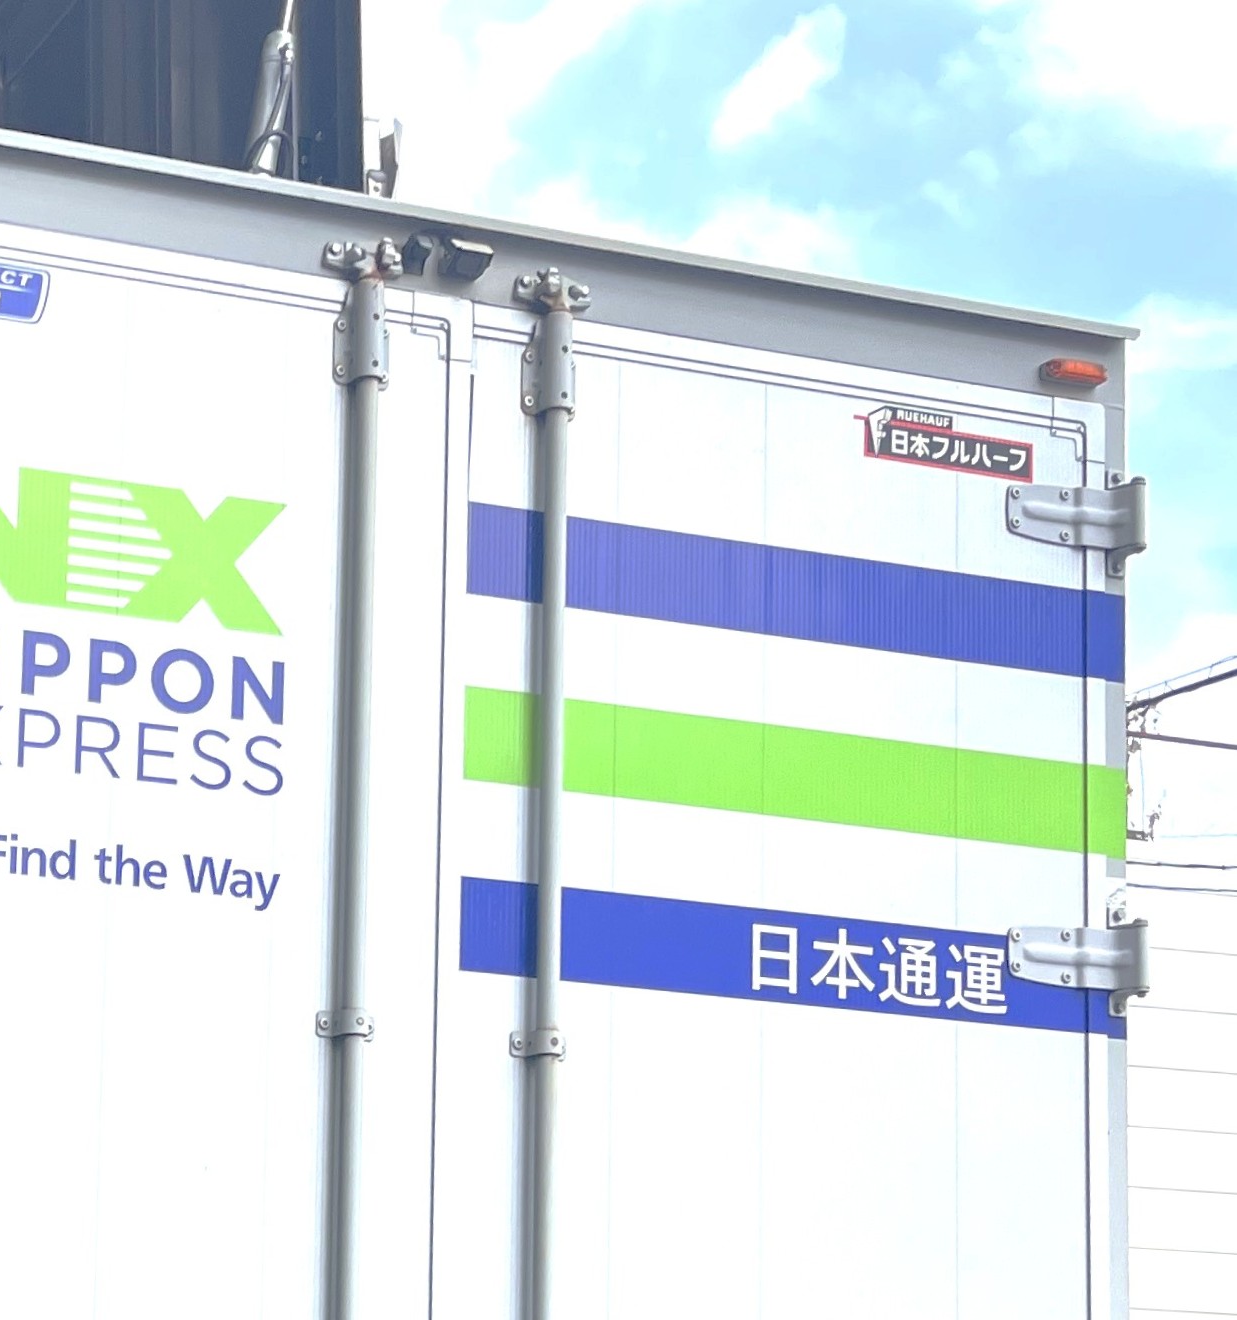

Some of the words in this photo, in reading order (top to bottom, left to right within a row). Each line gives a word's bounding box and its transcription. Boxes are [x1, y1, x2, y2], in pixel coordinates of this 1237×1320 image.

[890, 428, 1027, 472] 日本フルハーフ
[94, 844, 168, 890] the
[183, 854, 281, 912] Way
[750, 922, 1008, 1015] 日本通運
